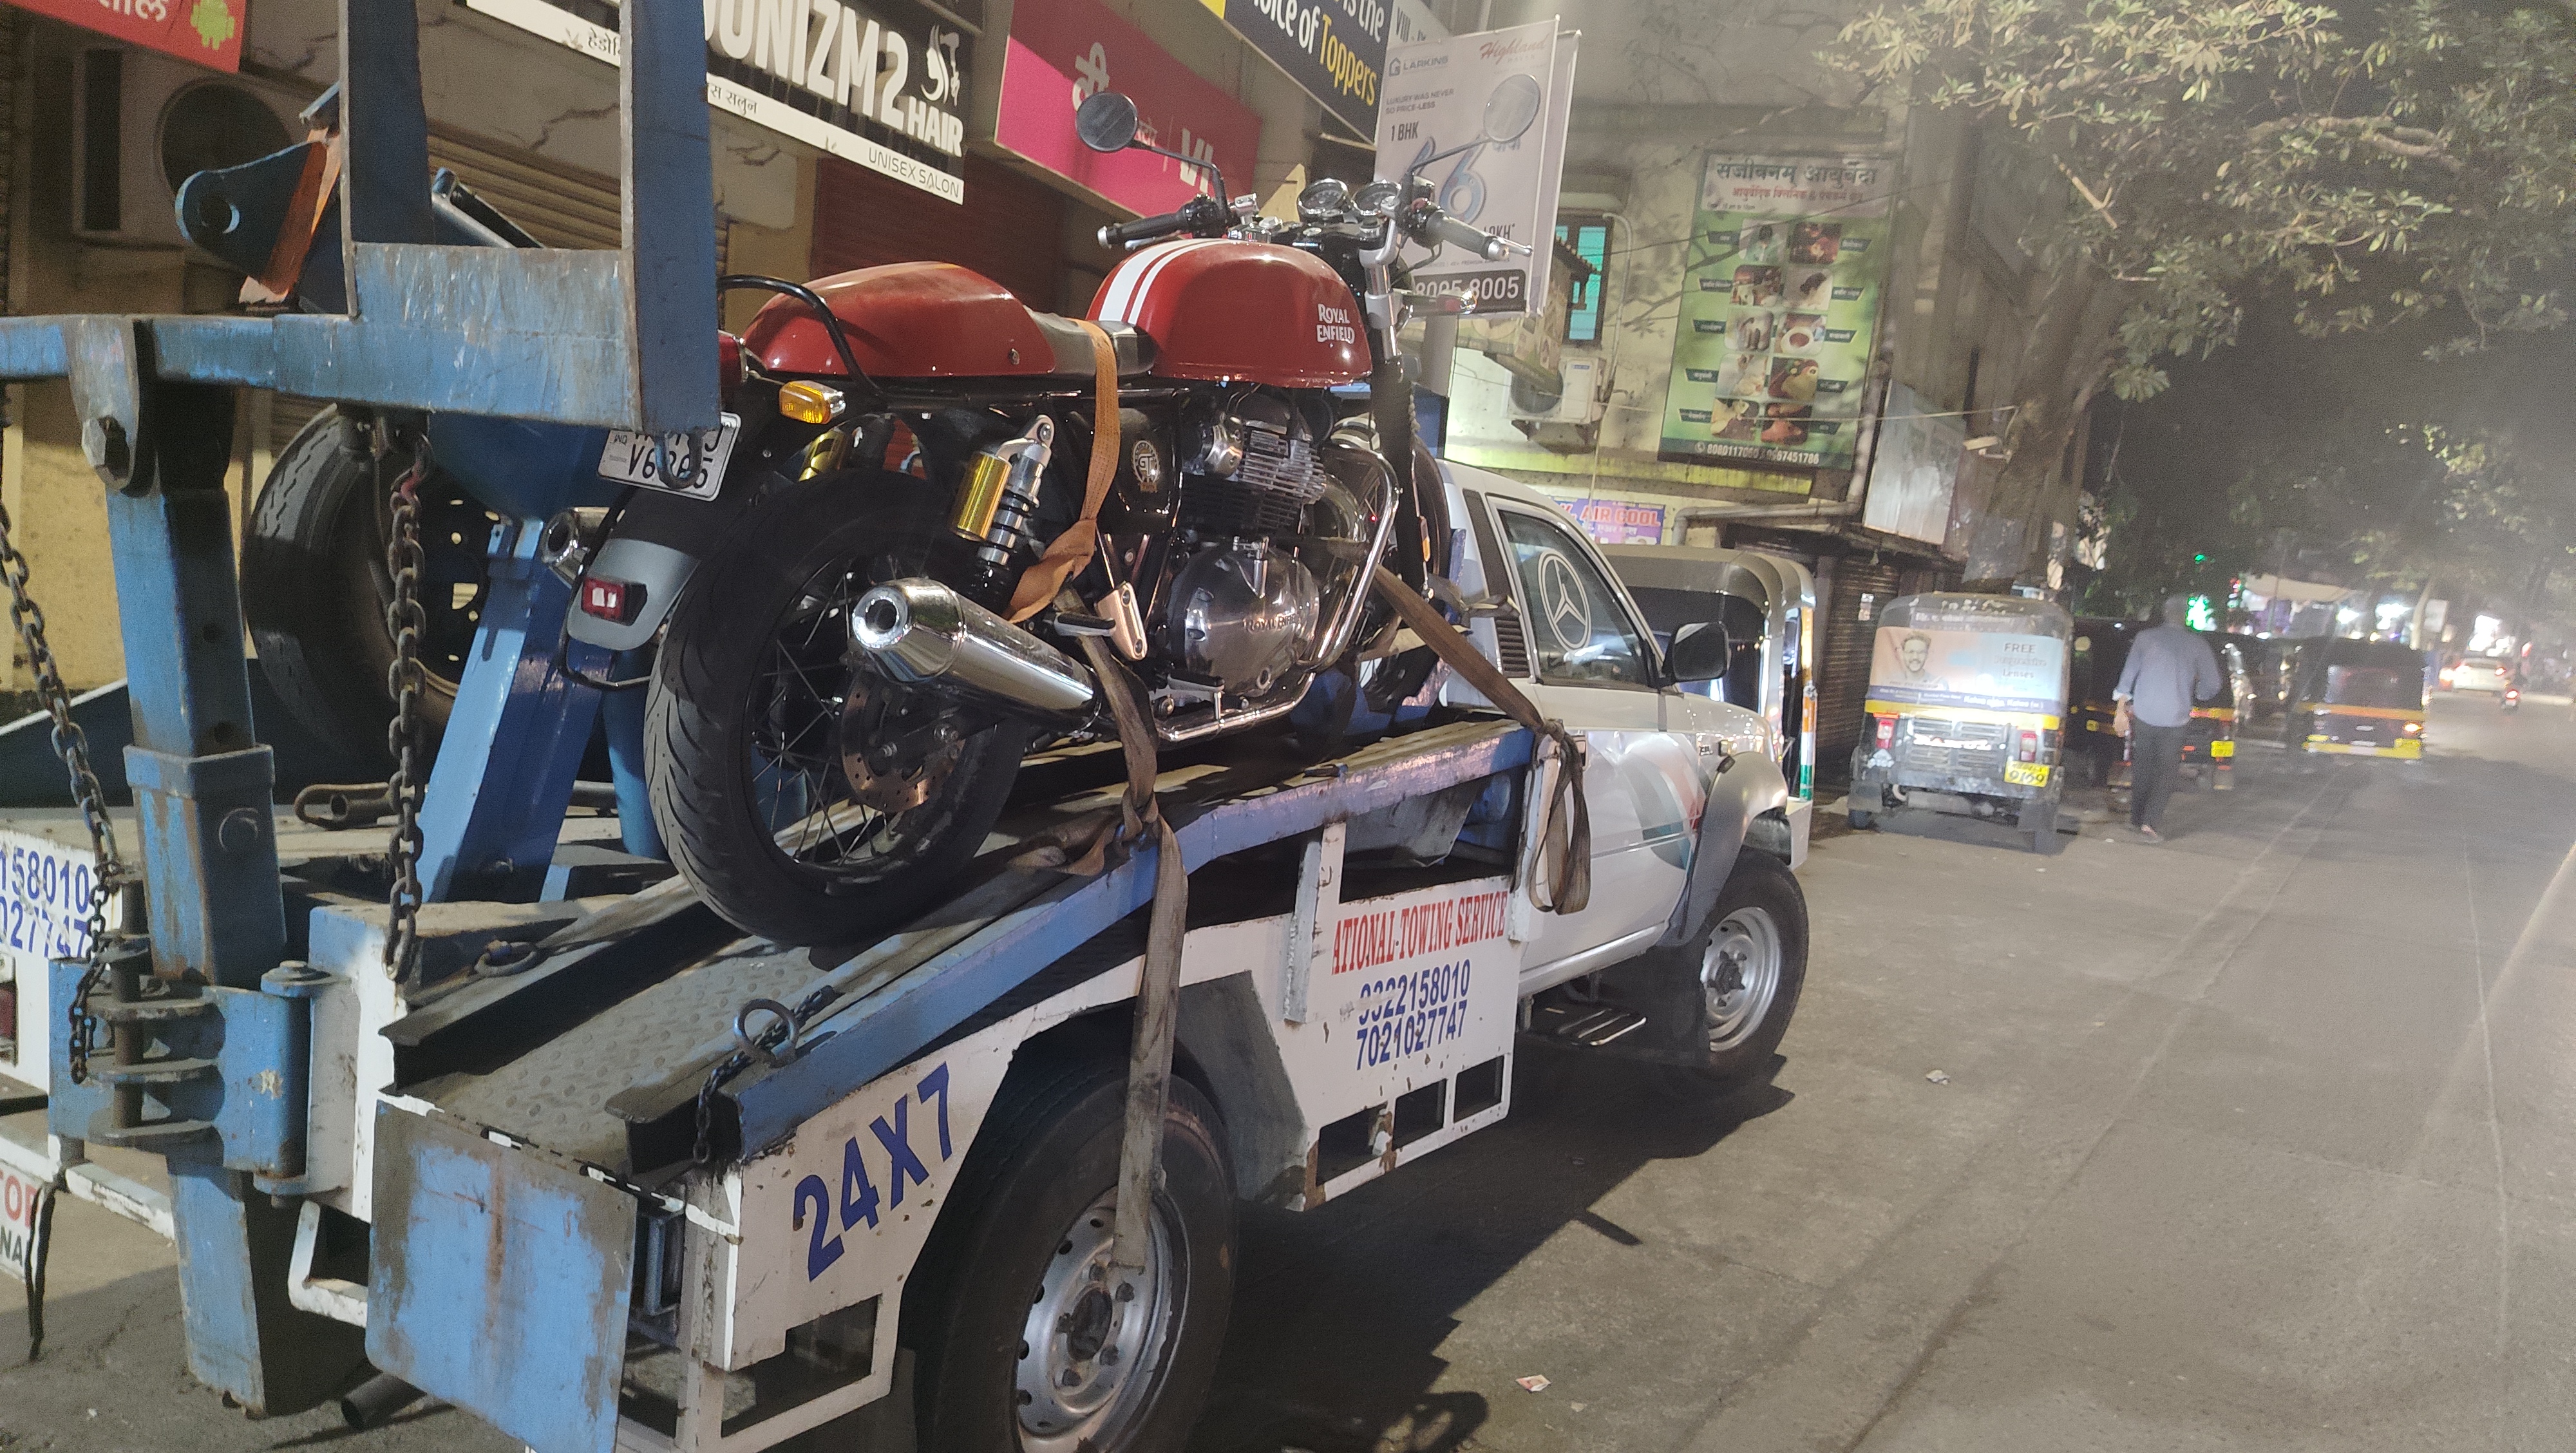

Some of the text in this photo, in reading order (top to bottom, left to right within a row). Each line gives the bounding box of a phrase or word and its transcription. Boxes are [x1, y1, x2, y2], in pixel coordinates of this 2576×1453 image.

[1298, 5, 1320, 54] of
[1320, 14, 1377, 106] Toppers
[1414, 92, 1430, 101] WAS
[1430, 88, 1455, 98] NEVER
[907, 95, 962, 158] HAIR
[1392, 120, 1419, 142] 1 BHK
[868, 147, 960, 198] UNISEX SALON
[1469, 276, 1520, 299] 8005
[1317, 303, 1350, 323] ROYAL
[1316, 324, 1356, 345] ENFIELD
[1580, 506, 1611, 522] AIR
[1615, 509, 1661, 527] COOL
[2003, 643, 2036, 654] FREE
[1399, 899, 1454, 959] TOWING
[1455, 891, 1508, 947] SERVICE
[1356, 1000, 1468, 1070] 7021027747
[793, 1061, 952, 1282] 24X7
